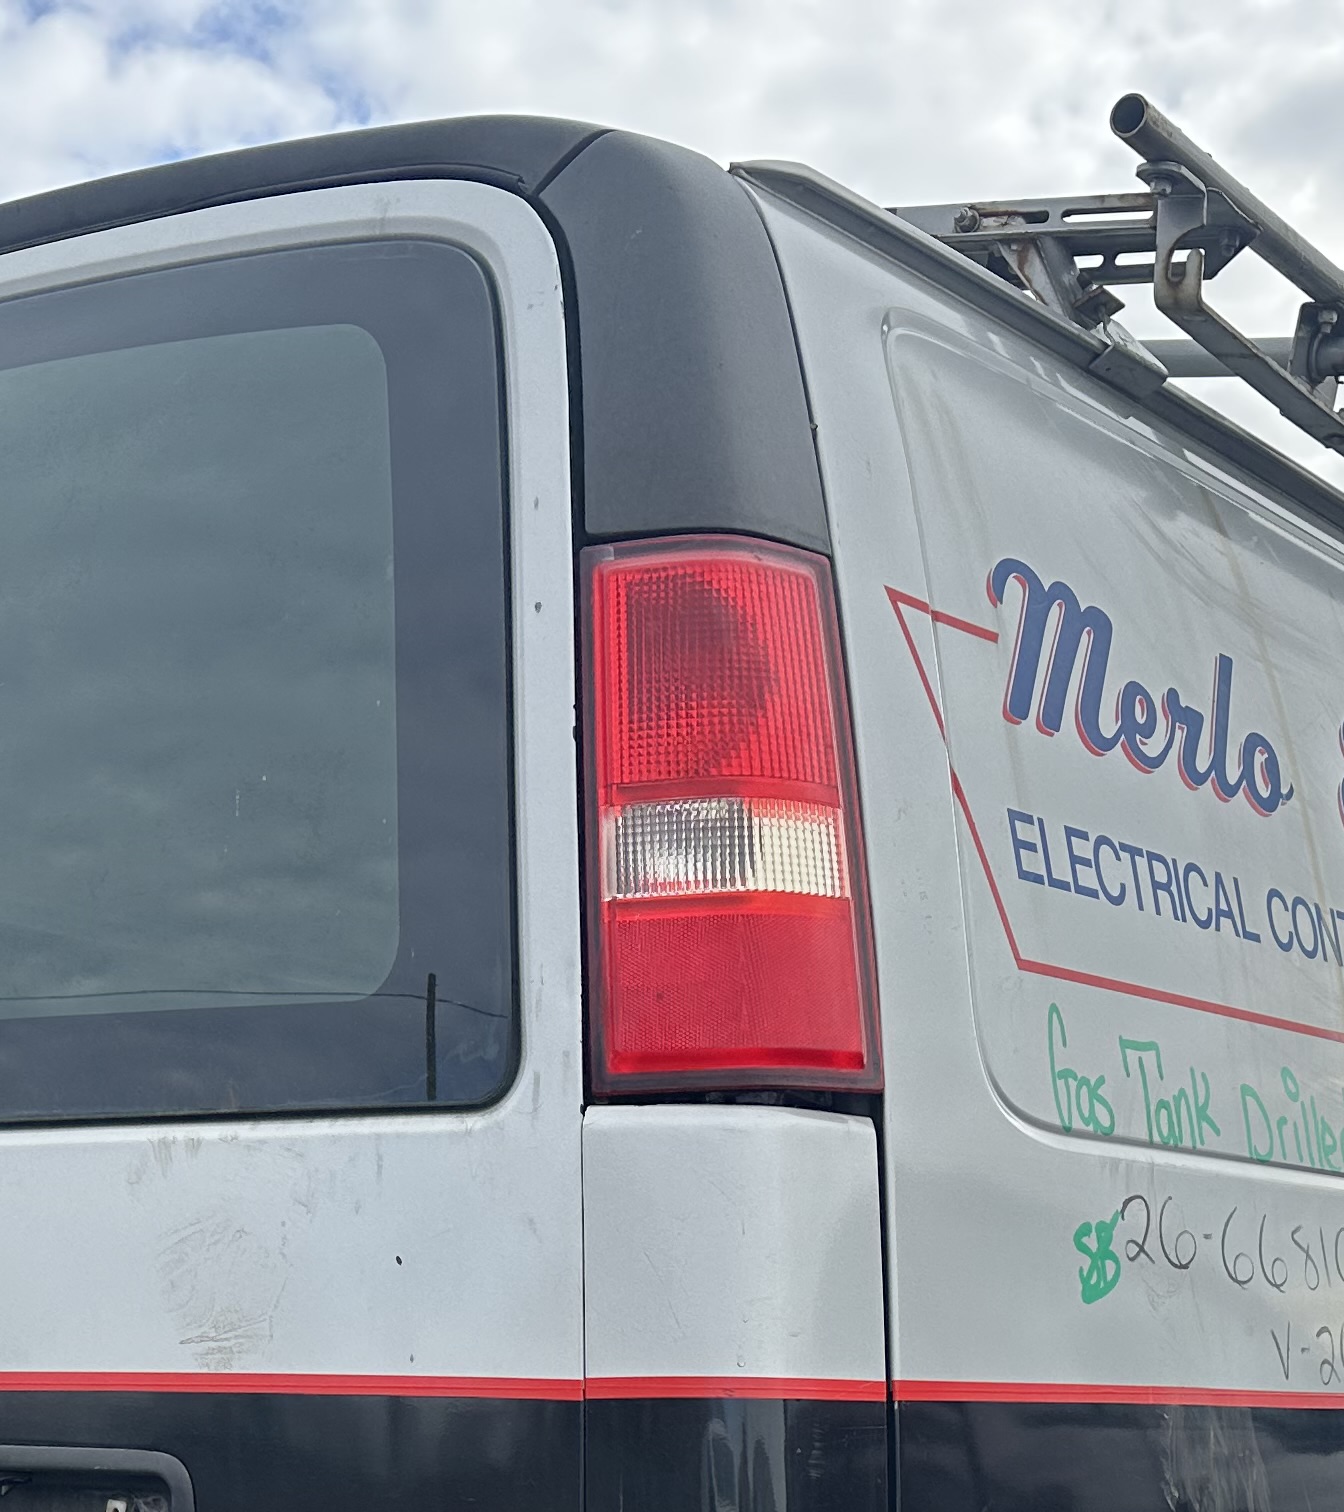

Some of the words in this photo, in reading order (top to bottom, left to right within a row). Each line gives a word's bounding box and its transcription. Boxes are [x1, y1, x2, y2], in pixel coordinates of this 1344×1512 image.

[985, 558, 1294, 817] Merlo
[1007, 807, 1260, 945] ELECTRICAL
[1047, 1002, 1115, 1135] Gas
[1119, 1035, 1221, 1150] Tank
